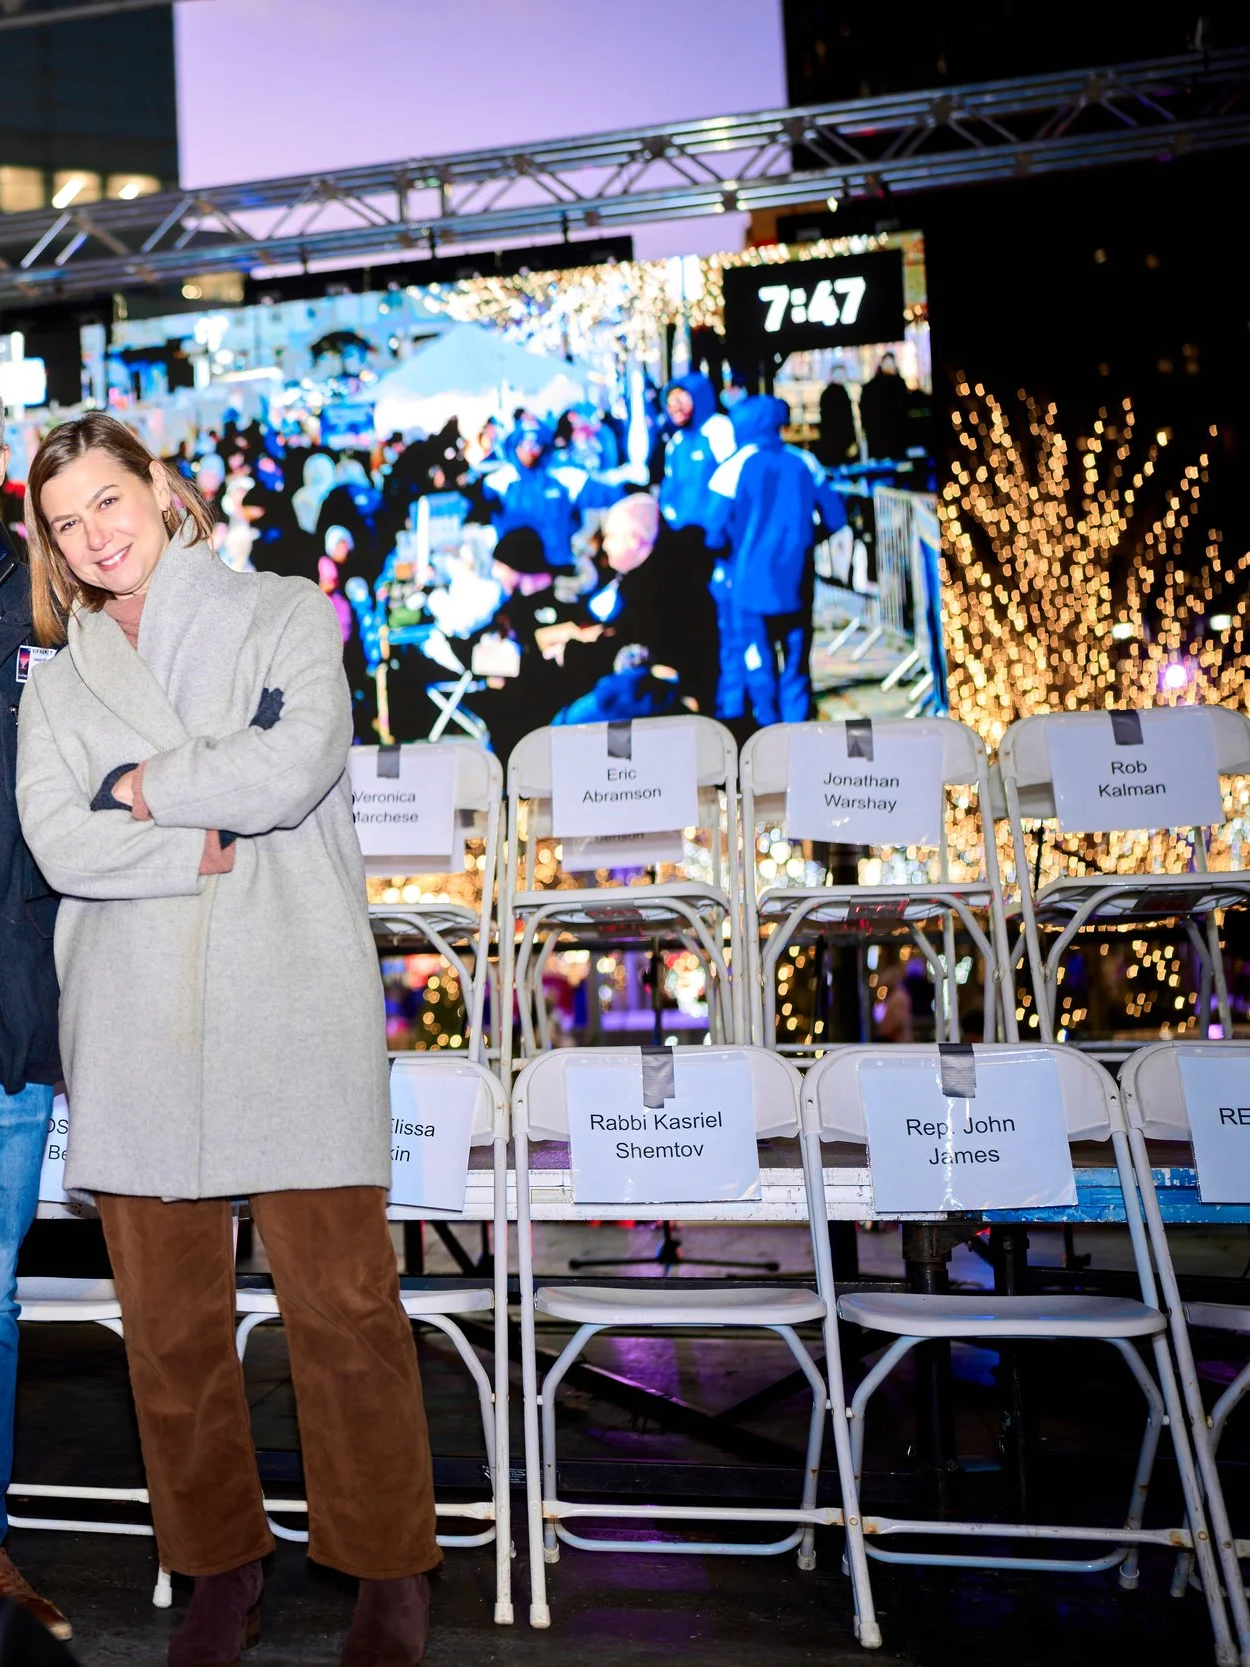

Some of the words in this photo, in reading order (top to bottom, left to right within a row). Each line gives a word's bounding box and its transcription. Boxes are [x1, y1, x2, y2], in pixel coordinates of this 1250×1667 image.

[758, 276, 866, 332] 7:47
[607, 767, 636, 782] Eric
[1111, 760, 1147, 775] Rob
[823, 772, 900, 788] Jonathan
[354, 790, 416, 803] Veronica
[583, 786, 661, 803] Abramson
[1098, 781, 1166, 798] Kalman
[824, 793, 897, 812] Warshay
[590, 1114, 647, 1131] Rabbi
[654, 1111, 723, 1130] Kasriel
[906, 1119, 955, 1139] Rep.
[963, 1116, 1015, 1134] John
[616, 1142, 704, 1159] Shemtov
[929, 1148, 1000, 1165] James
